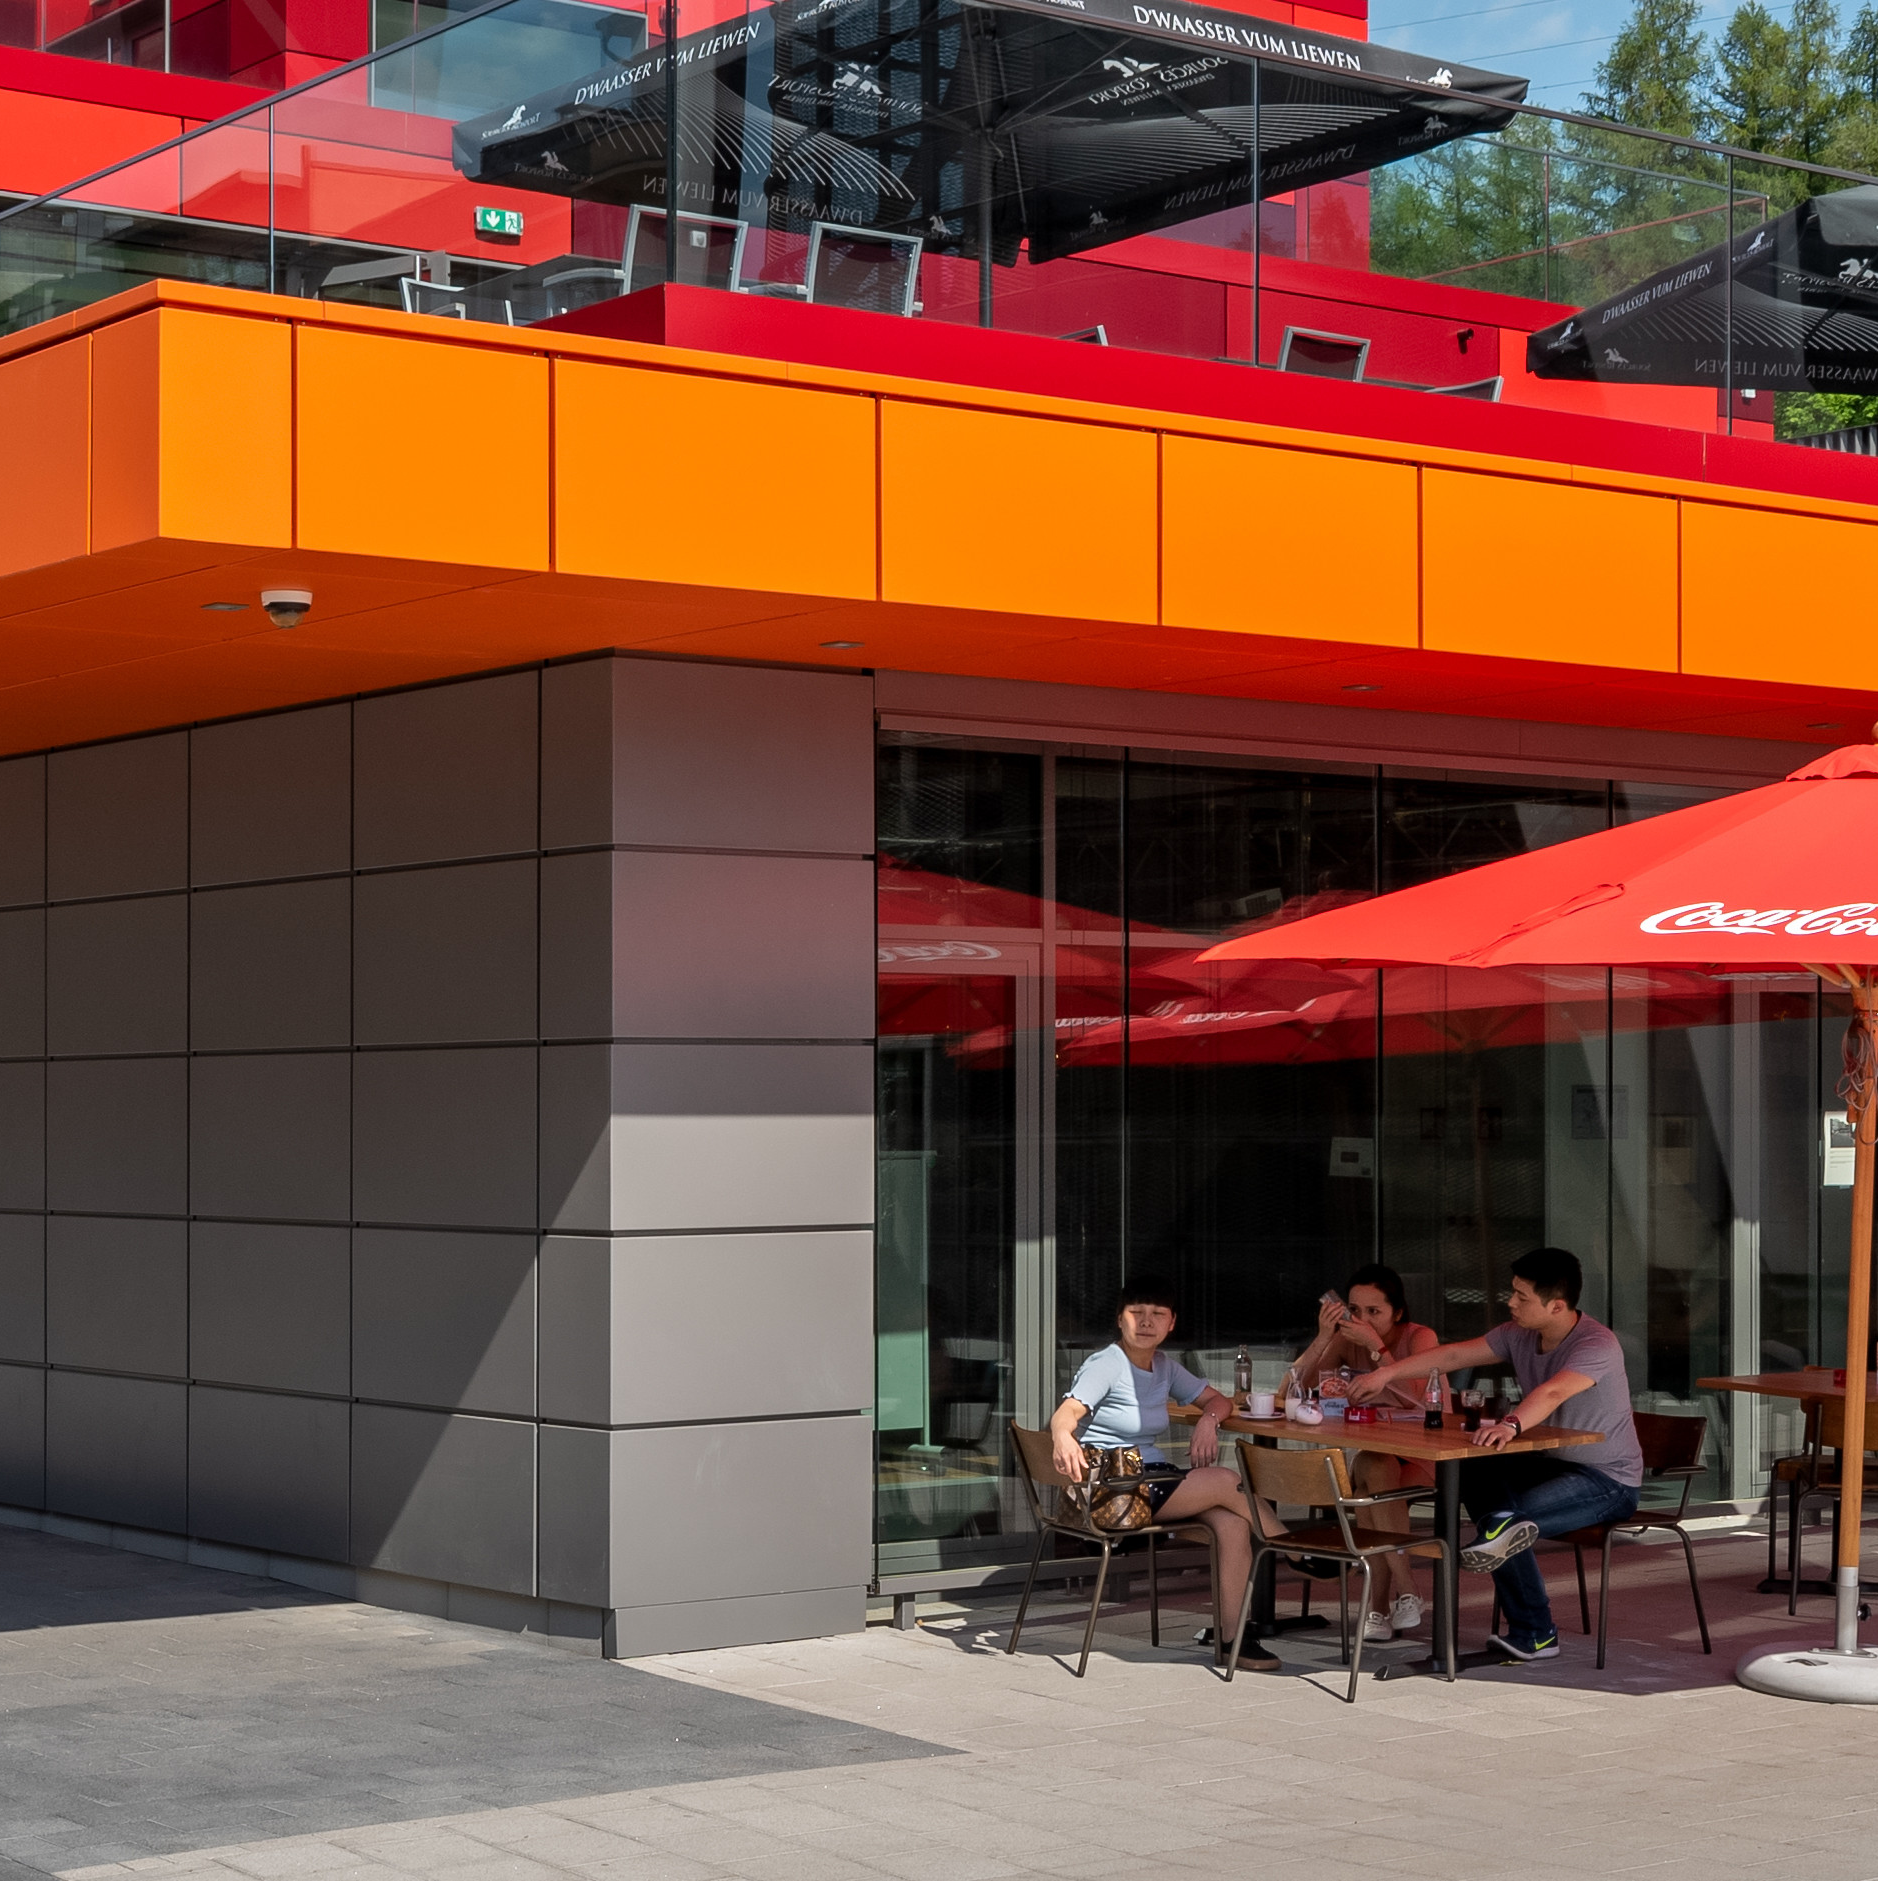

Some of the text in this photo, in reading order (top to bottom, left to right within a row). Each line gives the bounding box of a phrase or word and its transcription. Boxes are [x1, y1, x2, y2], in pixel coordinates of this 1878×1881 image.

[574, 62, 652, 106] D'WAASSER
[698, 21, 761, 59] LIEWEN
[1133, 5, 1362, 72] D'WAASSER VUM LIEWEN
